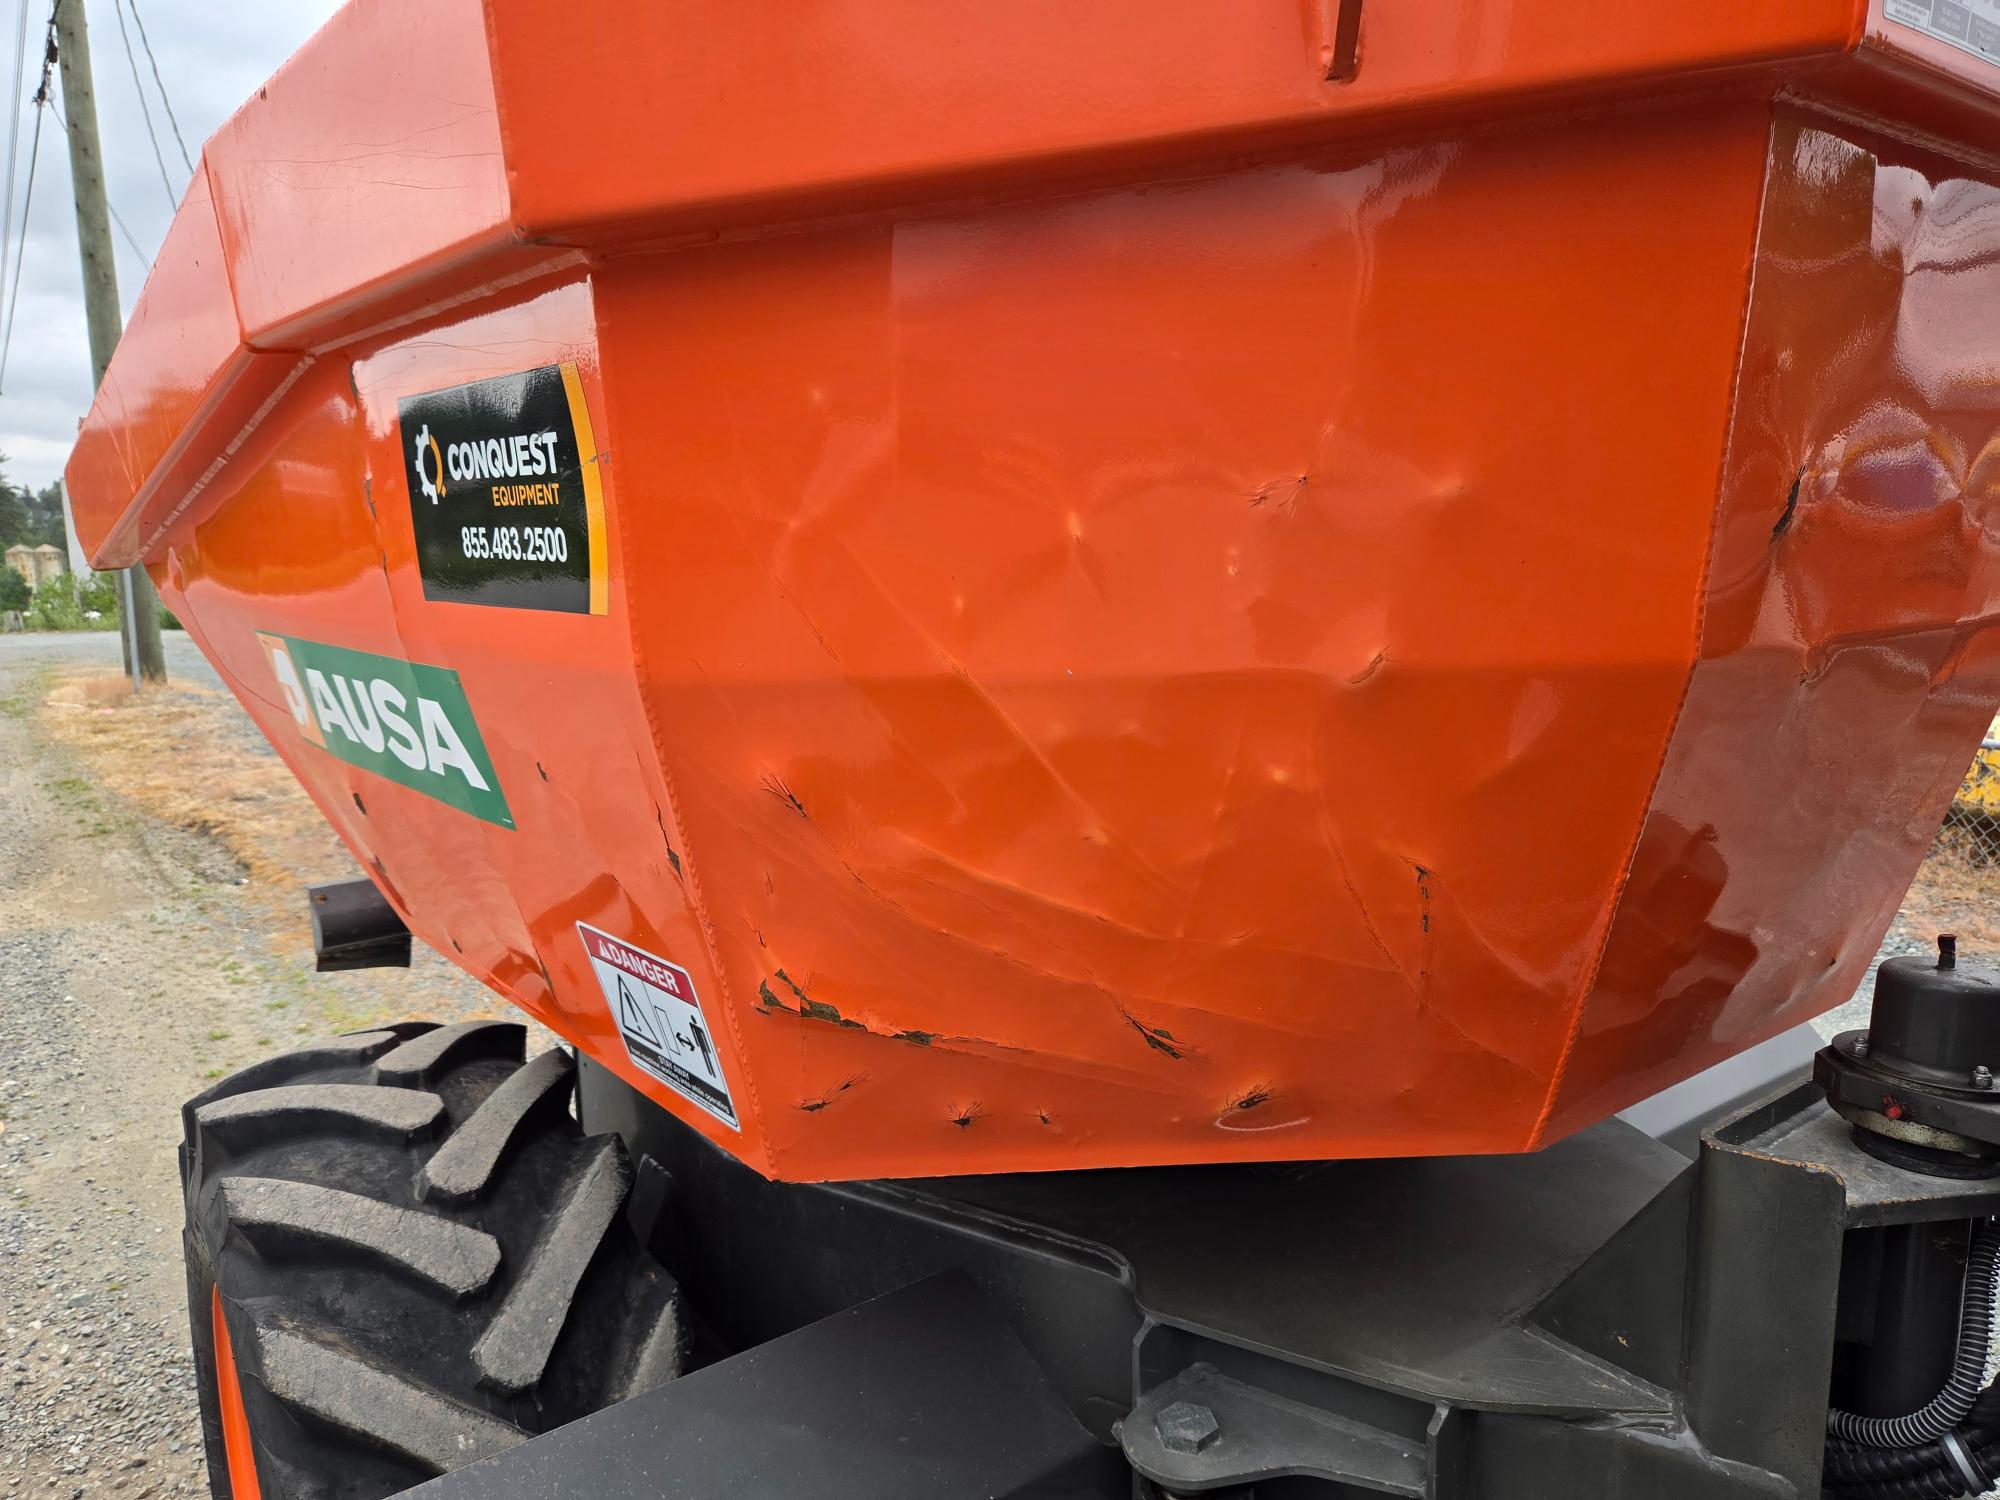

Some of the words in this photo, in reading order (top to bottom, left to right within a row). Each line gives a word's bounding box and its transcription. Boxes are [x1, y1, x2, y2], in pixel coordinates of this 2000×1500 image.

[448, 432, 557, 481] CONQUEST
[492, 483, 560, 507] EQUIPMENT
[461, 526, 568, 563] 855.483.2500
[304, 667, 491, 792] AUSA
[608, 943, 680, 994] DANGER
